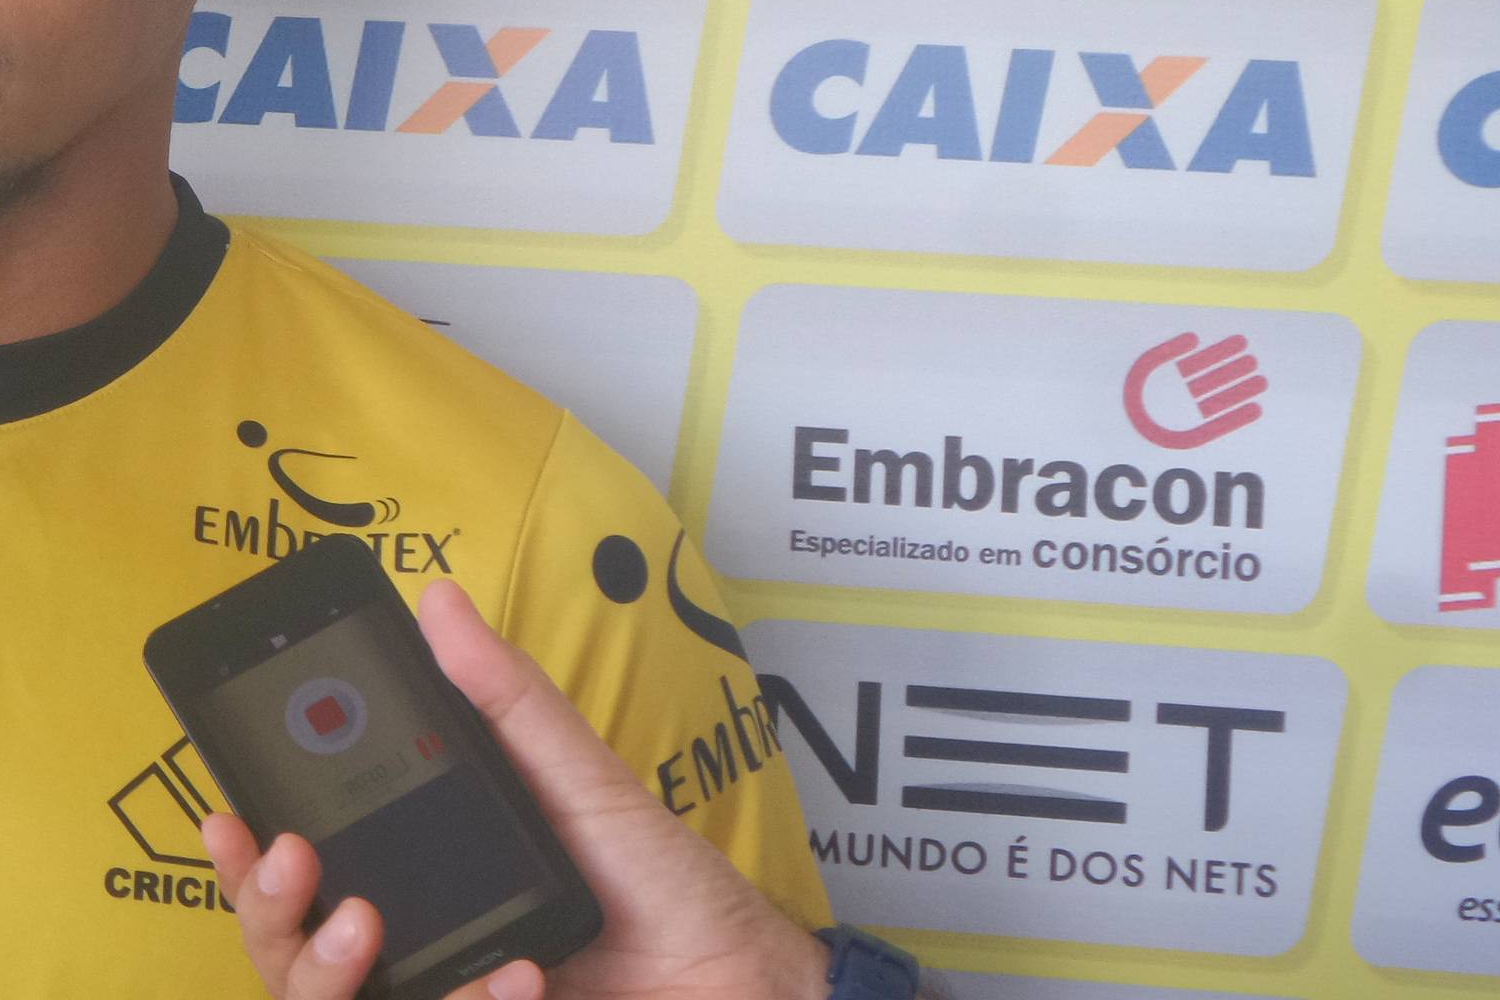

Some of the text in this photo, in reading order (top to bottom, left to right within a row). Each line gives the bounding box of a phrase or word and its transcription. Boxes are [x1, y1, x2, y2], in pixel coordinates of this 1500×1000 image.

[172, 11, 655, 144] CAIXA
[769, 38, 1316, 177] CAIXA
[792, 426, 1264, 530] Embracon
[790, 530, 1262, 582] Especializado em consórcio
[755, 673, 1287, 833] NET
[104, 867, 237, 913] CRICI
[809, 828, 1278, 899] MUNDO É DOS NETS
